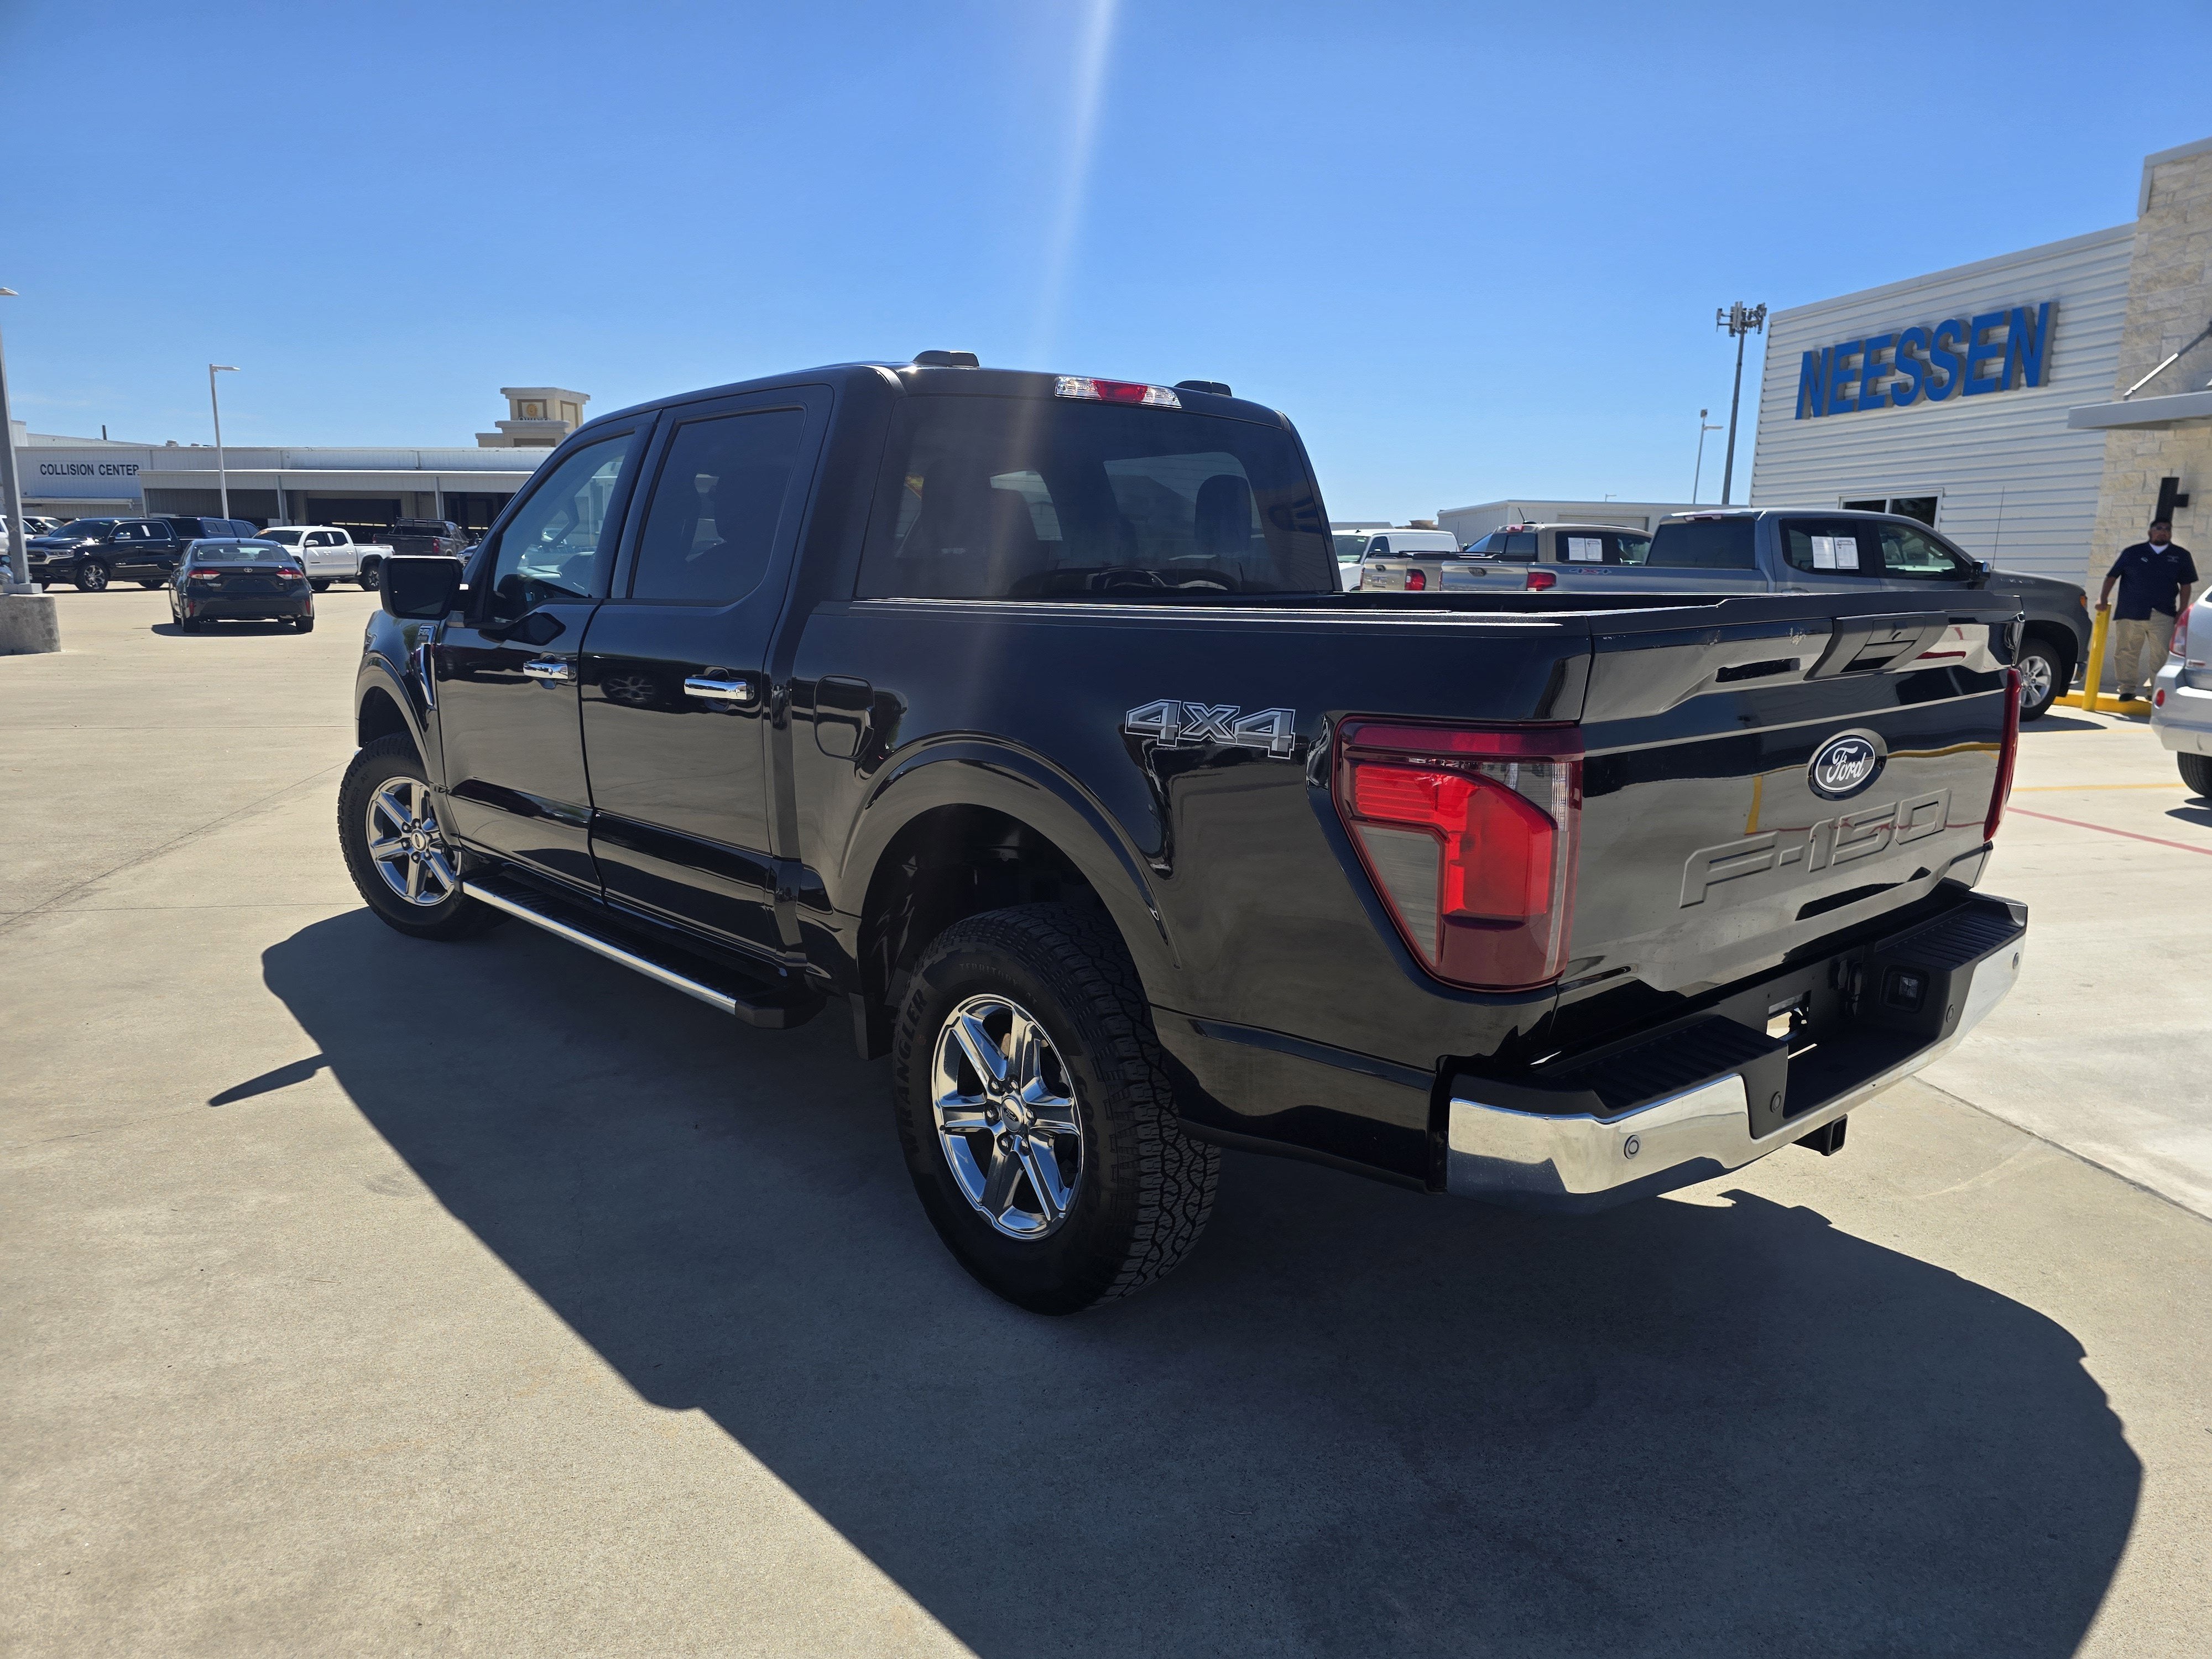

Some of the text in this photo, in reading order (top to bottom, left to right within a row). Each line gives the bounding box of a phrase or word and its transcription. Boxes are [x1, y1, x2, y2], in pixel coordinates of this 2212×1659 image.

[1795, 302, 2055, 420] NEESSEN
[40, 464, 139, 476] COLLISION CENTER
[1827, 747, 1866, 783] Ford
[1679, 788, 1951, 909] F-150
[896, 988, 929, 1156] WRANGLER
